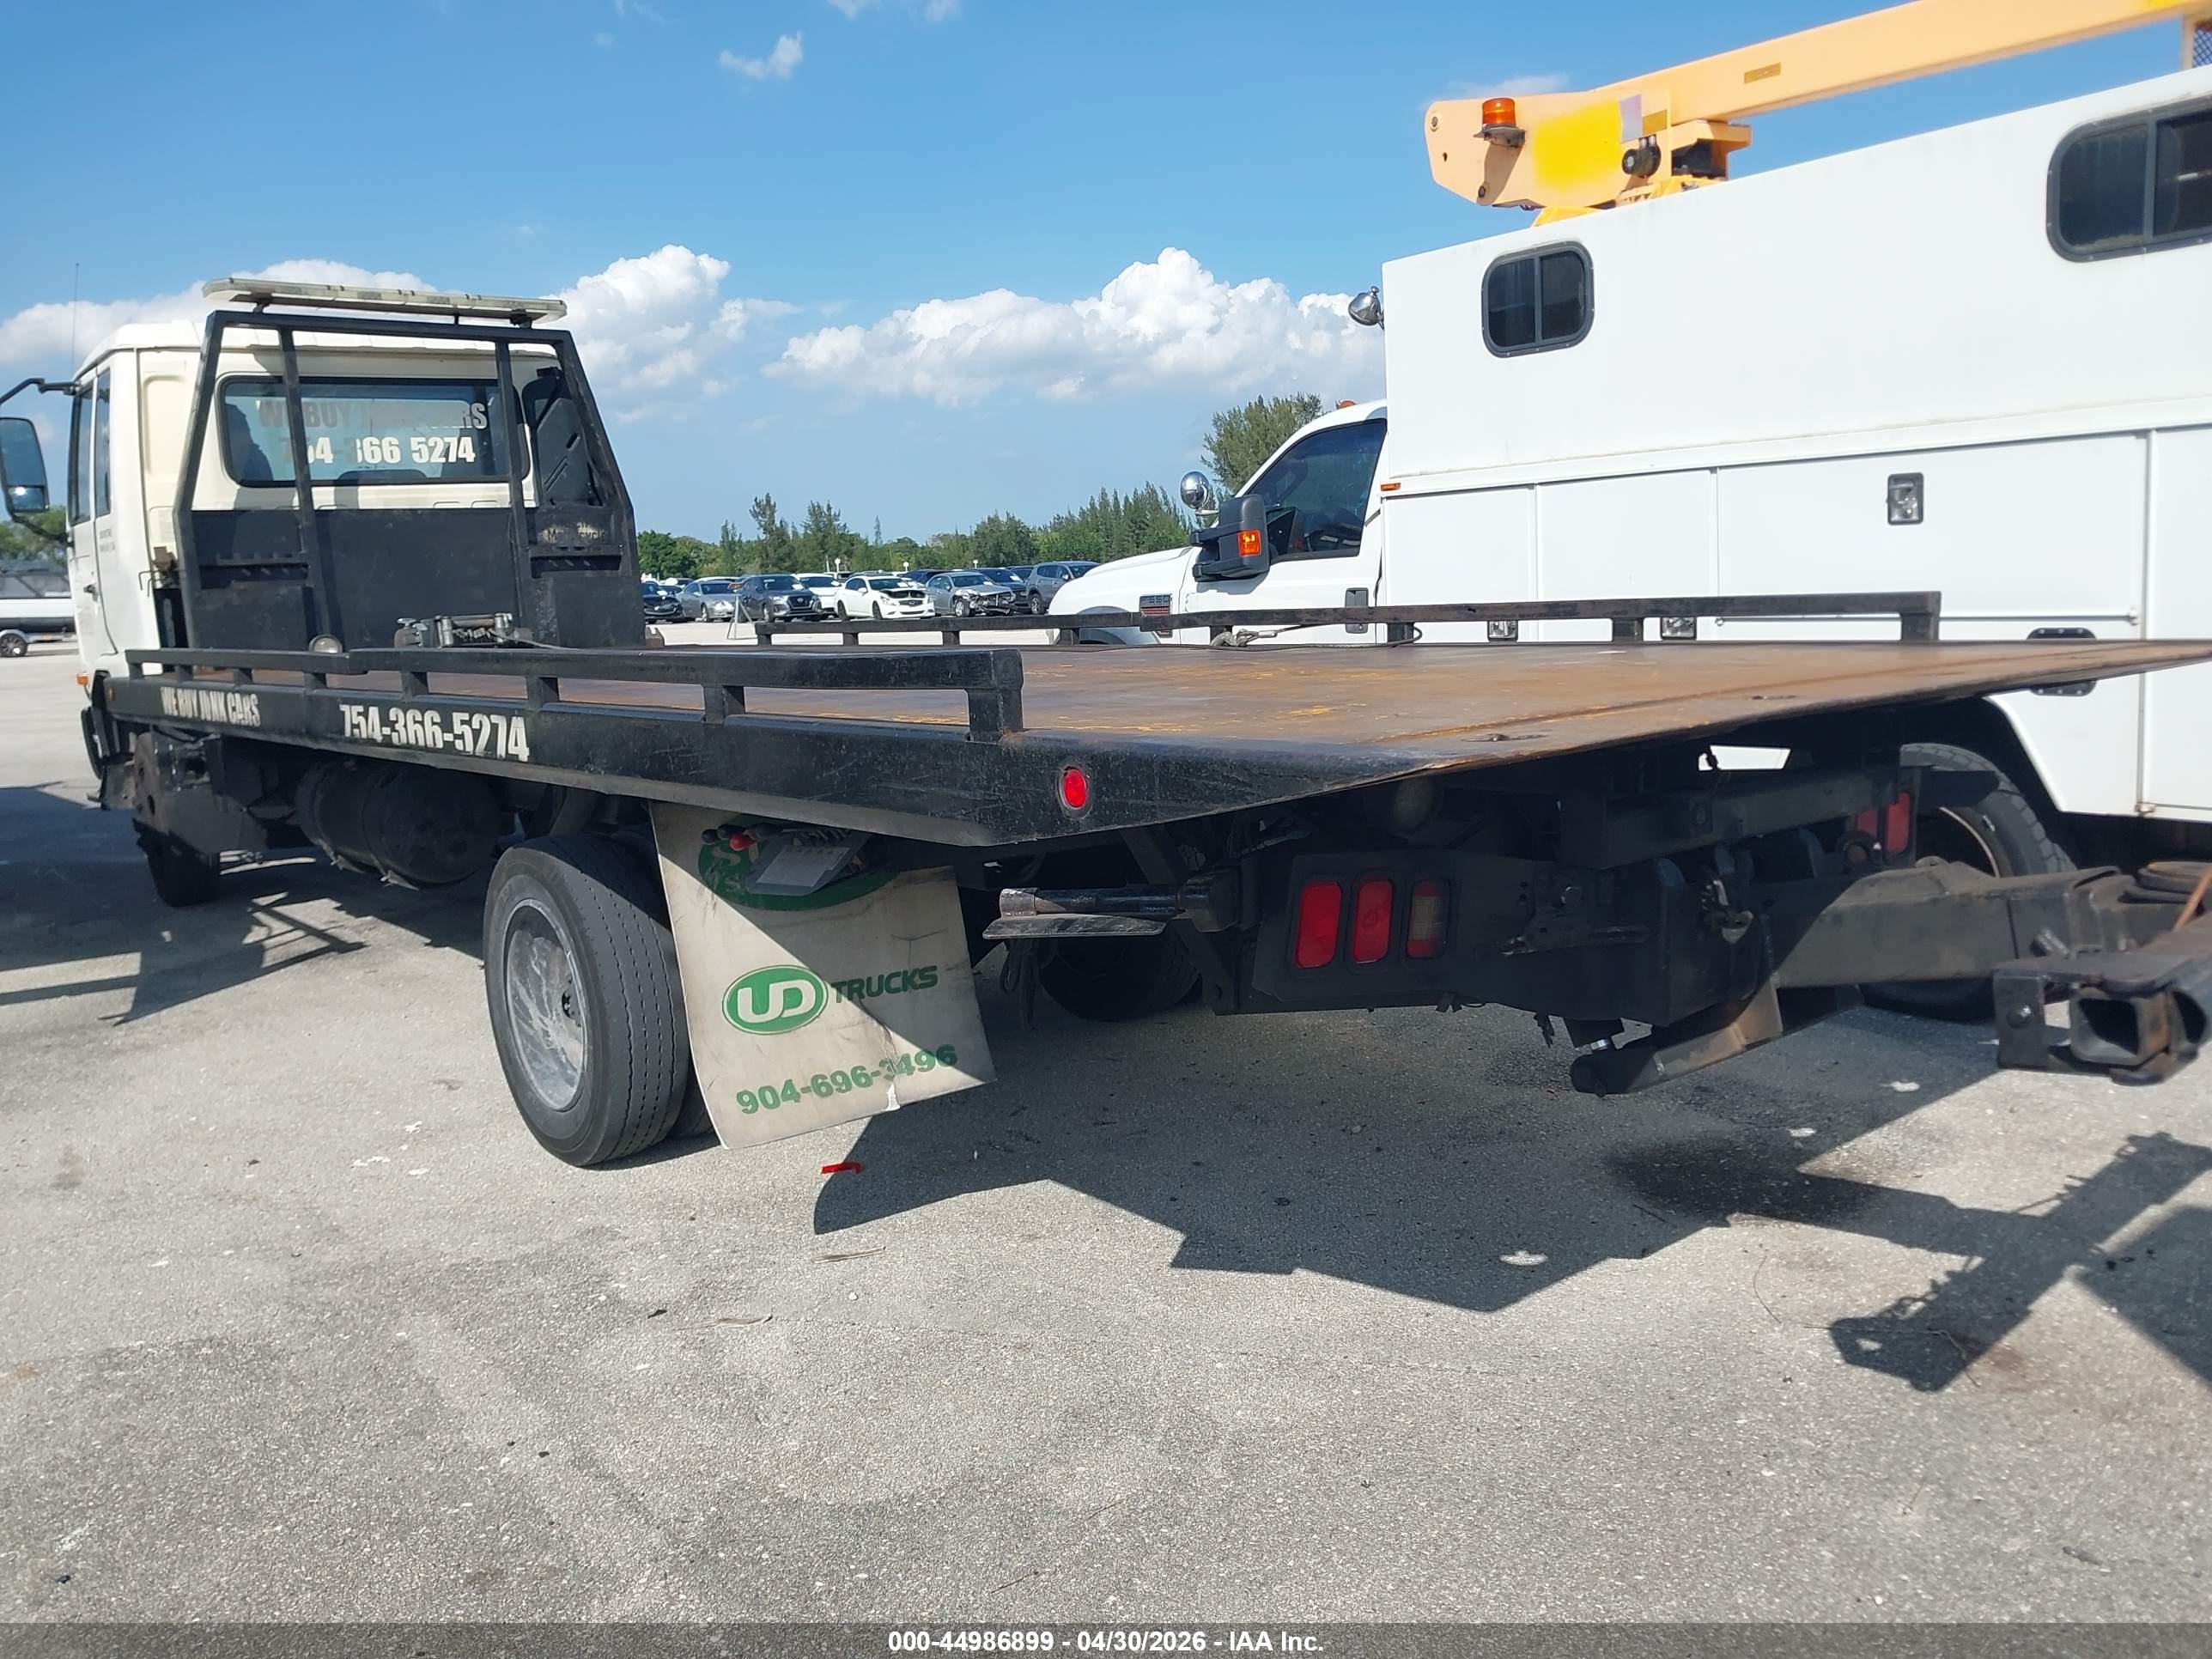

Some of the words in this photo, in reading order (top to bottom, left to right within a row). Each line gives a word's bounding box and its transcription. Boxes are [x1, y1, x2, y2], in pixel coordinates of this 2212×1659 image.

[410, 436, 476, 464] 5274
[161, 686, 179, 718] WE
[177, 688, 198, 719] BUY
[198, 690, 228, 722] JUNK
[227, 691, 261, 727] CARS
[338, 703, 530, 763] 754-366-5274
[737, 979, 817, 1024] UD
[830, 965, 938, 1004] TRUCKS
